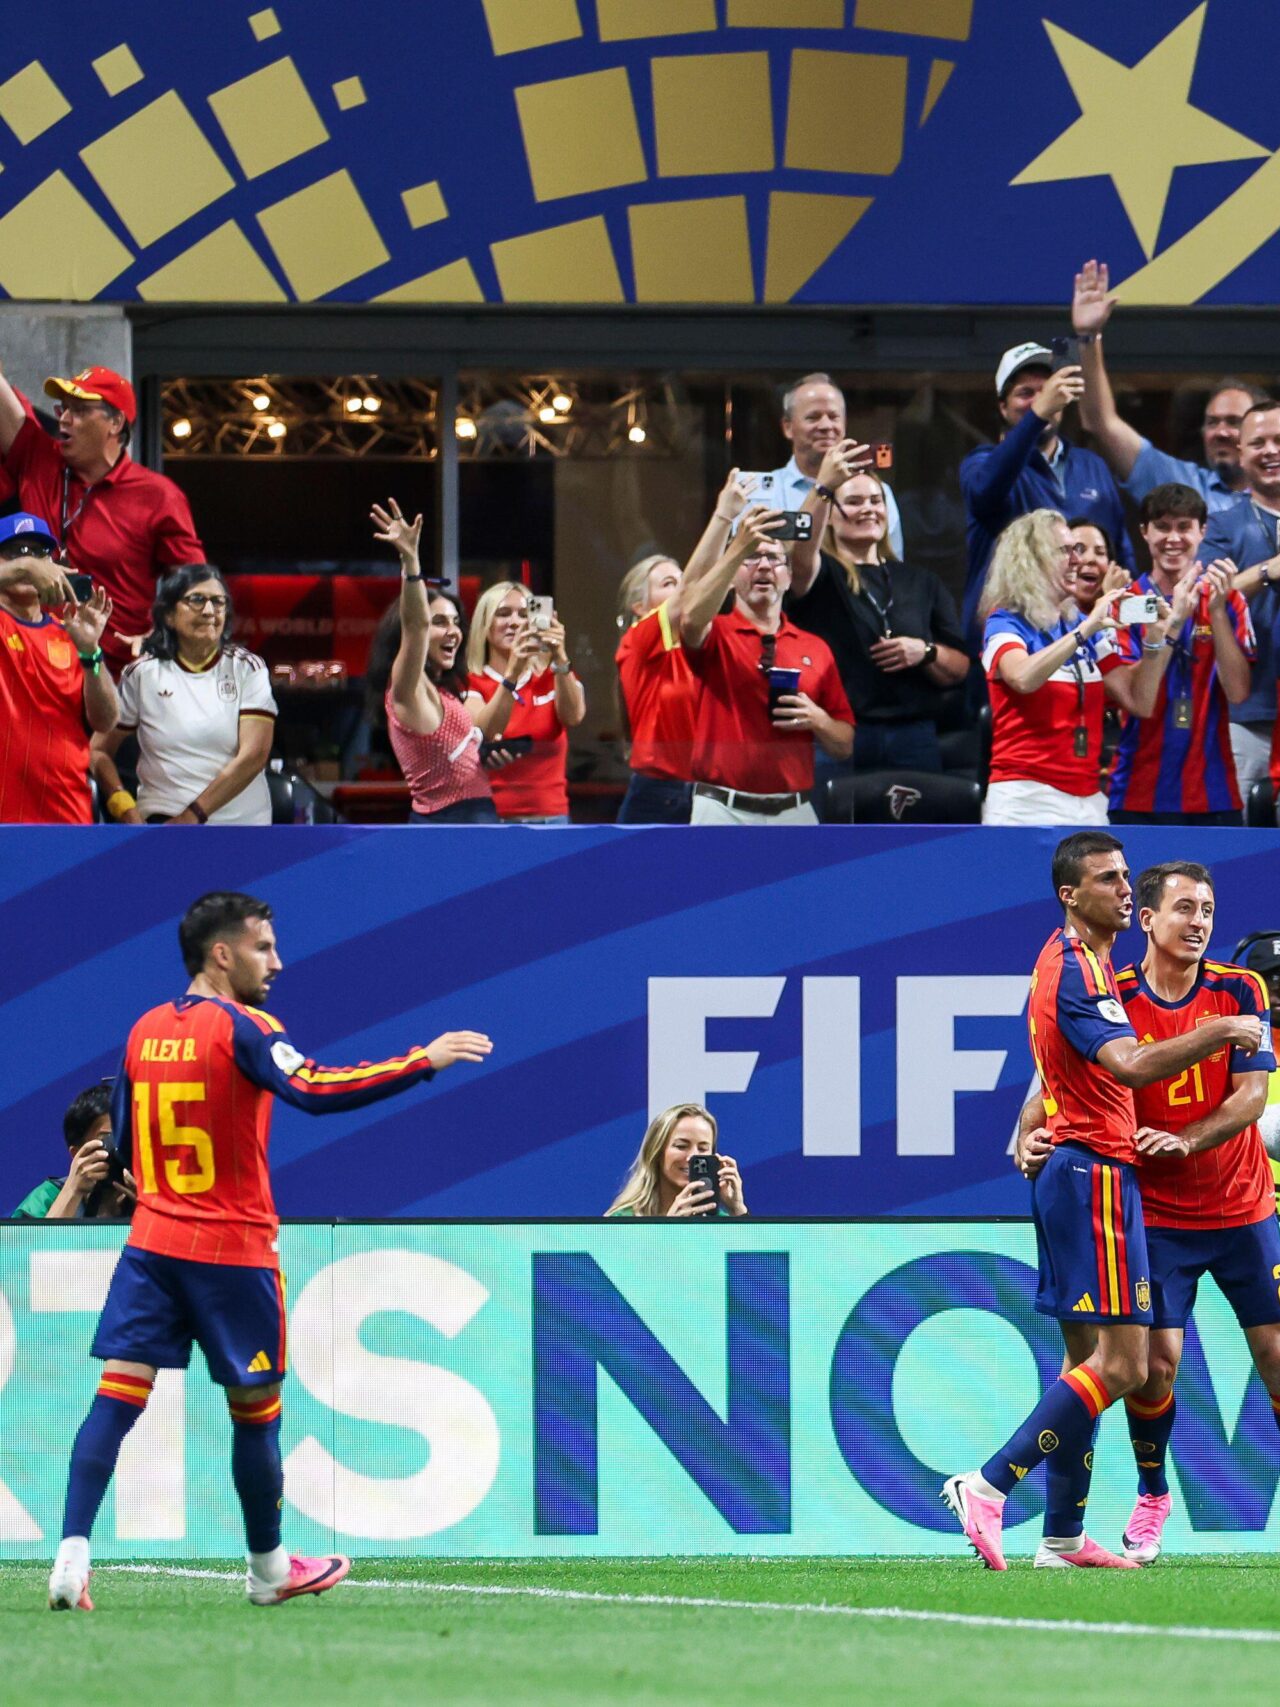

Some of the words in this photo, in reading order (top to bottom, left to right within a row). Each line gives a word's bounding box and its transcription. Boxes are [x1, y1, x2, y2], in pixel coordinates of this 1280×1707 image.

[140, 1038, 182, 1062] ALEX
[647, 975, 1046, 1156] FIF
[1168, 1062, 1205, 1106] 21
[133, 1082, 216, 1195] 15
